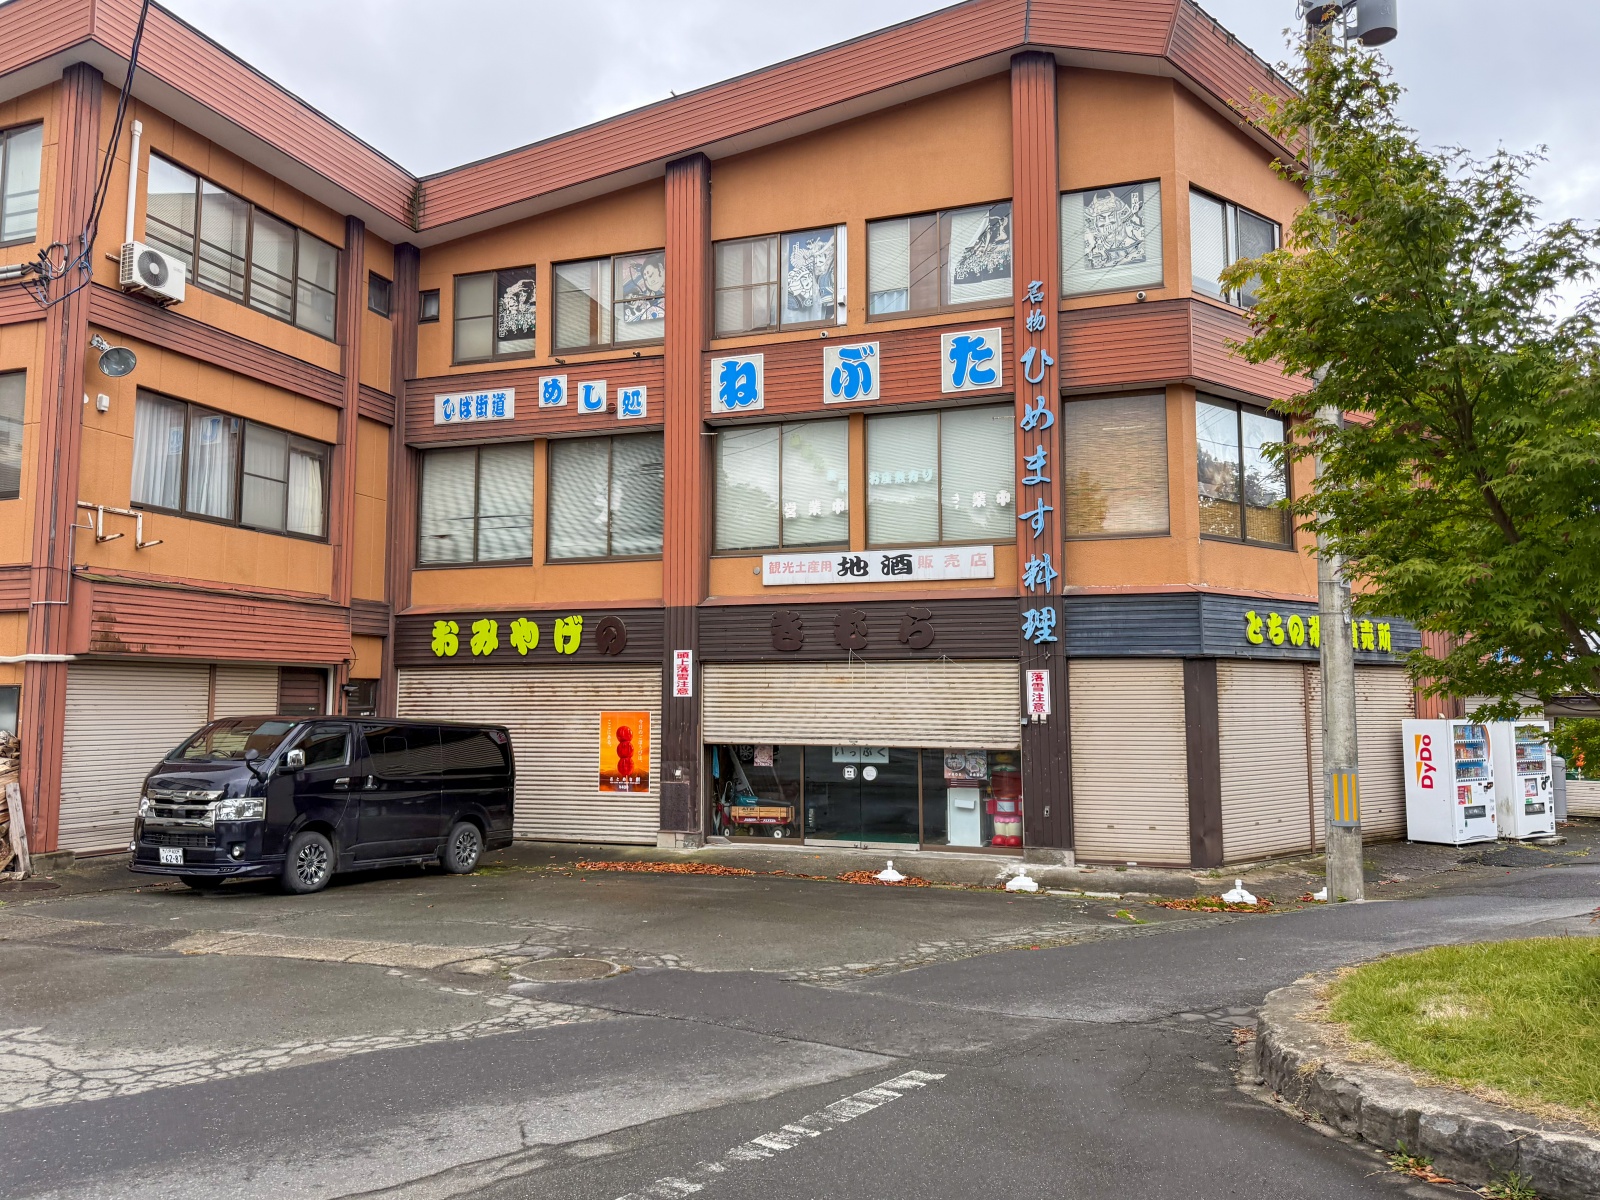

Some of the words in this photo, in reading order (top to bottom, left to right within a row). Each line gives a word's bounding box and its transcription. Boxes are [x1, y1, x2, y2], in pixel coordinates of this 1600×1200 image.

[719, 335, 997, 409] ねぶた
[442, 392, 507, 421] ひば街道
[542, 378, 642, 416] めし処
[677, 652, 689, 695] 頭上落雪注意
[1031, 672, 1046, 713] 落雪注意
[1420, 734, 1437, 790] DyDo
